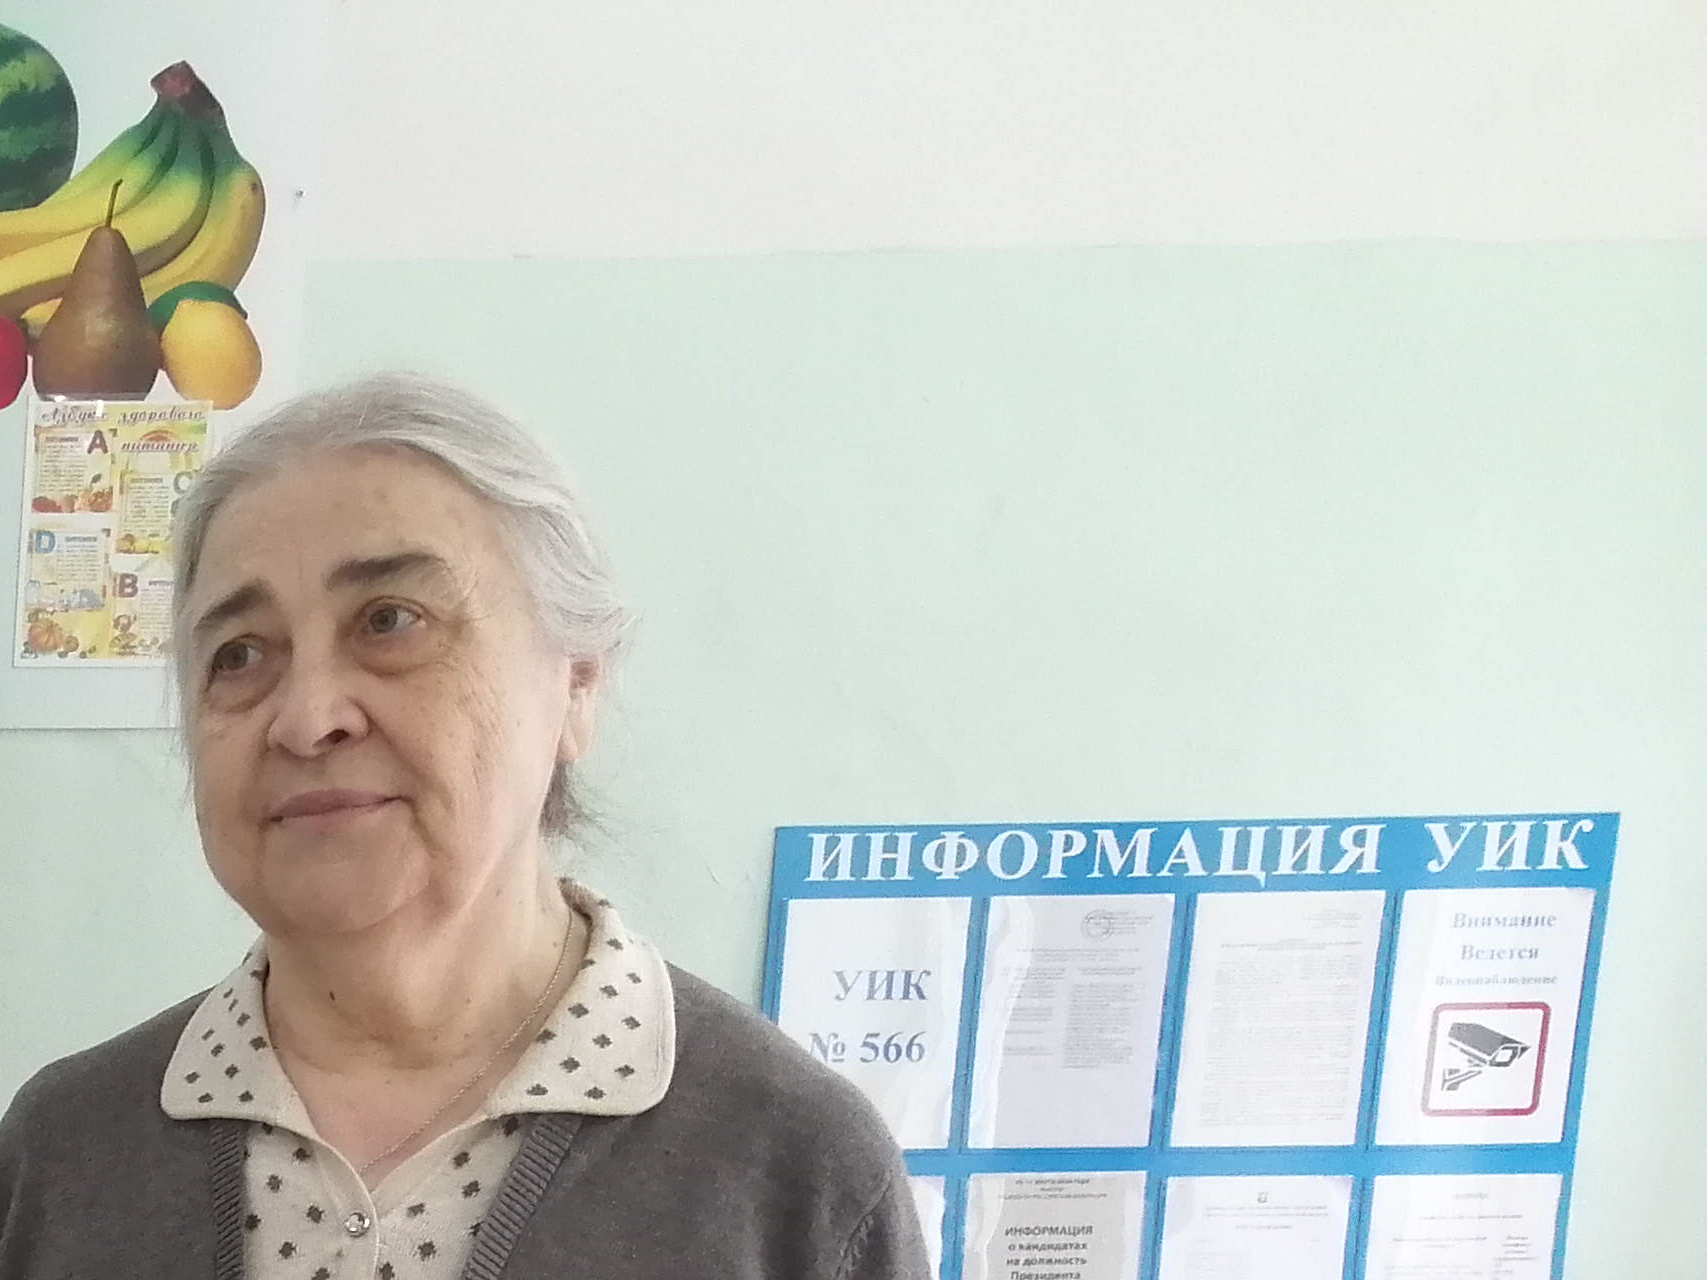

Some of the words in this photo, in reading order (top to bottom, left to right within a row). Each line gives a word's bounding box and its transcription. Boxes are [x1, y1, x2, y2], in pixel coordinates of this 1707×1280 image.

[804, 824, 1387, 888] ИНФОРМАЦИЯ
[1424, 819, 1595, 874] УИК
[1453, 912, 1557, 929] Внимание
[832, 969, 931, 1002] УИК
[809, 1032, 846, 1063] №
[859, 1031, 927, 1064] 566
[1004, 1225, 1094, 1237] ИНФОРМАЦИЯ
[1018, 1242, 1088, 1252] кандидатах
[1006, 1257, 1020, 1266] на
[1022, 1257, 1087, 1267] должность
[1010, 1270, 1082, 1280] Президента
